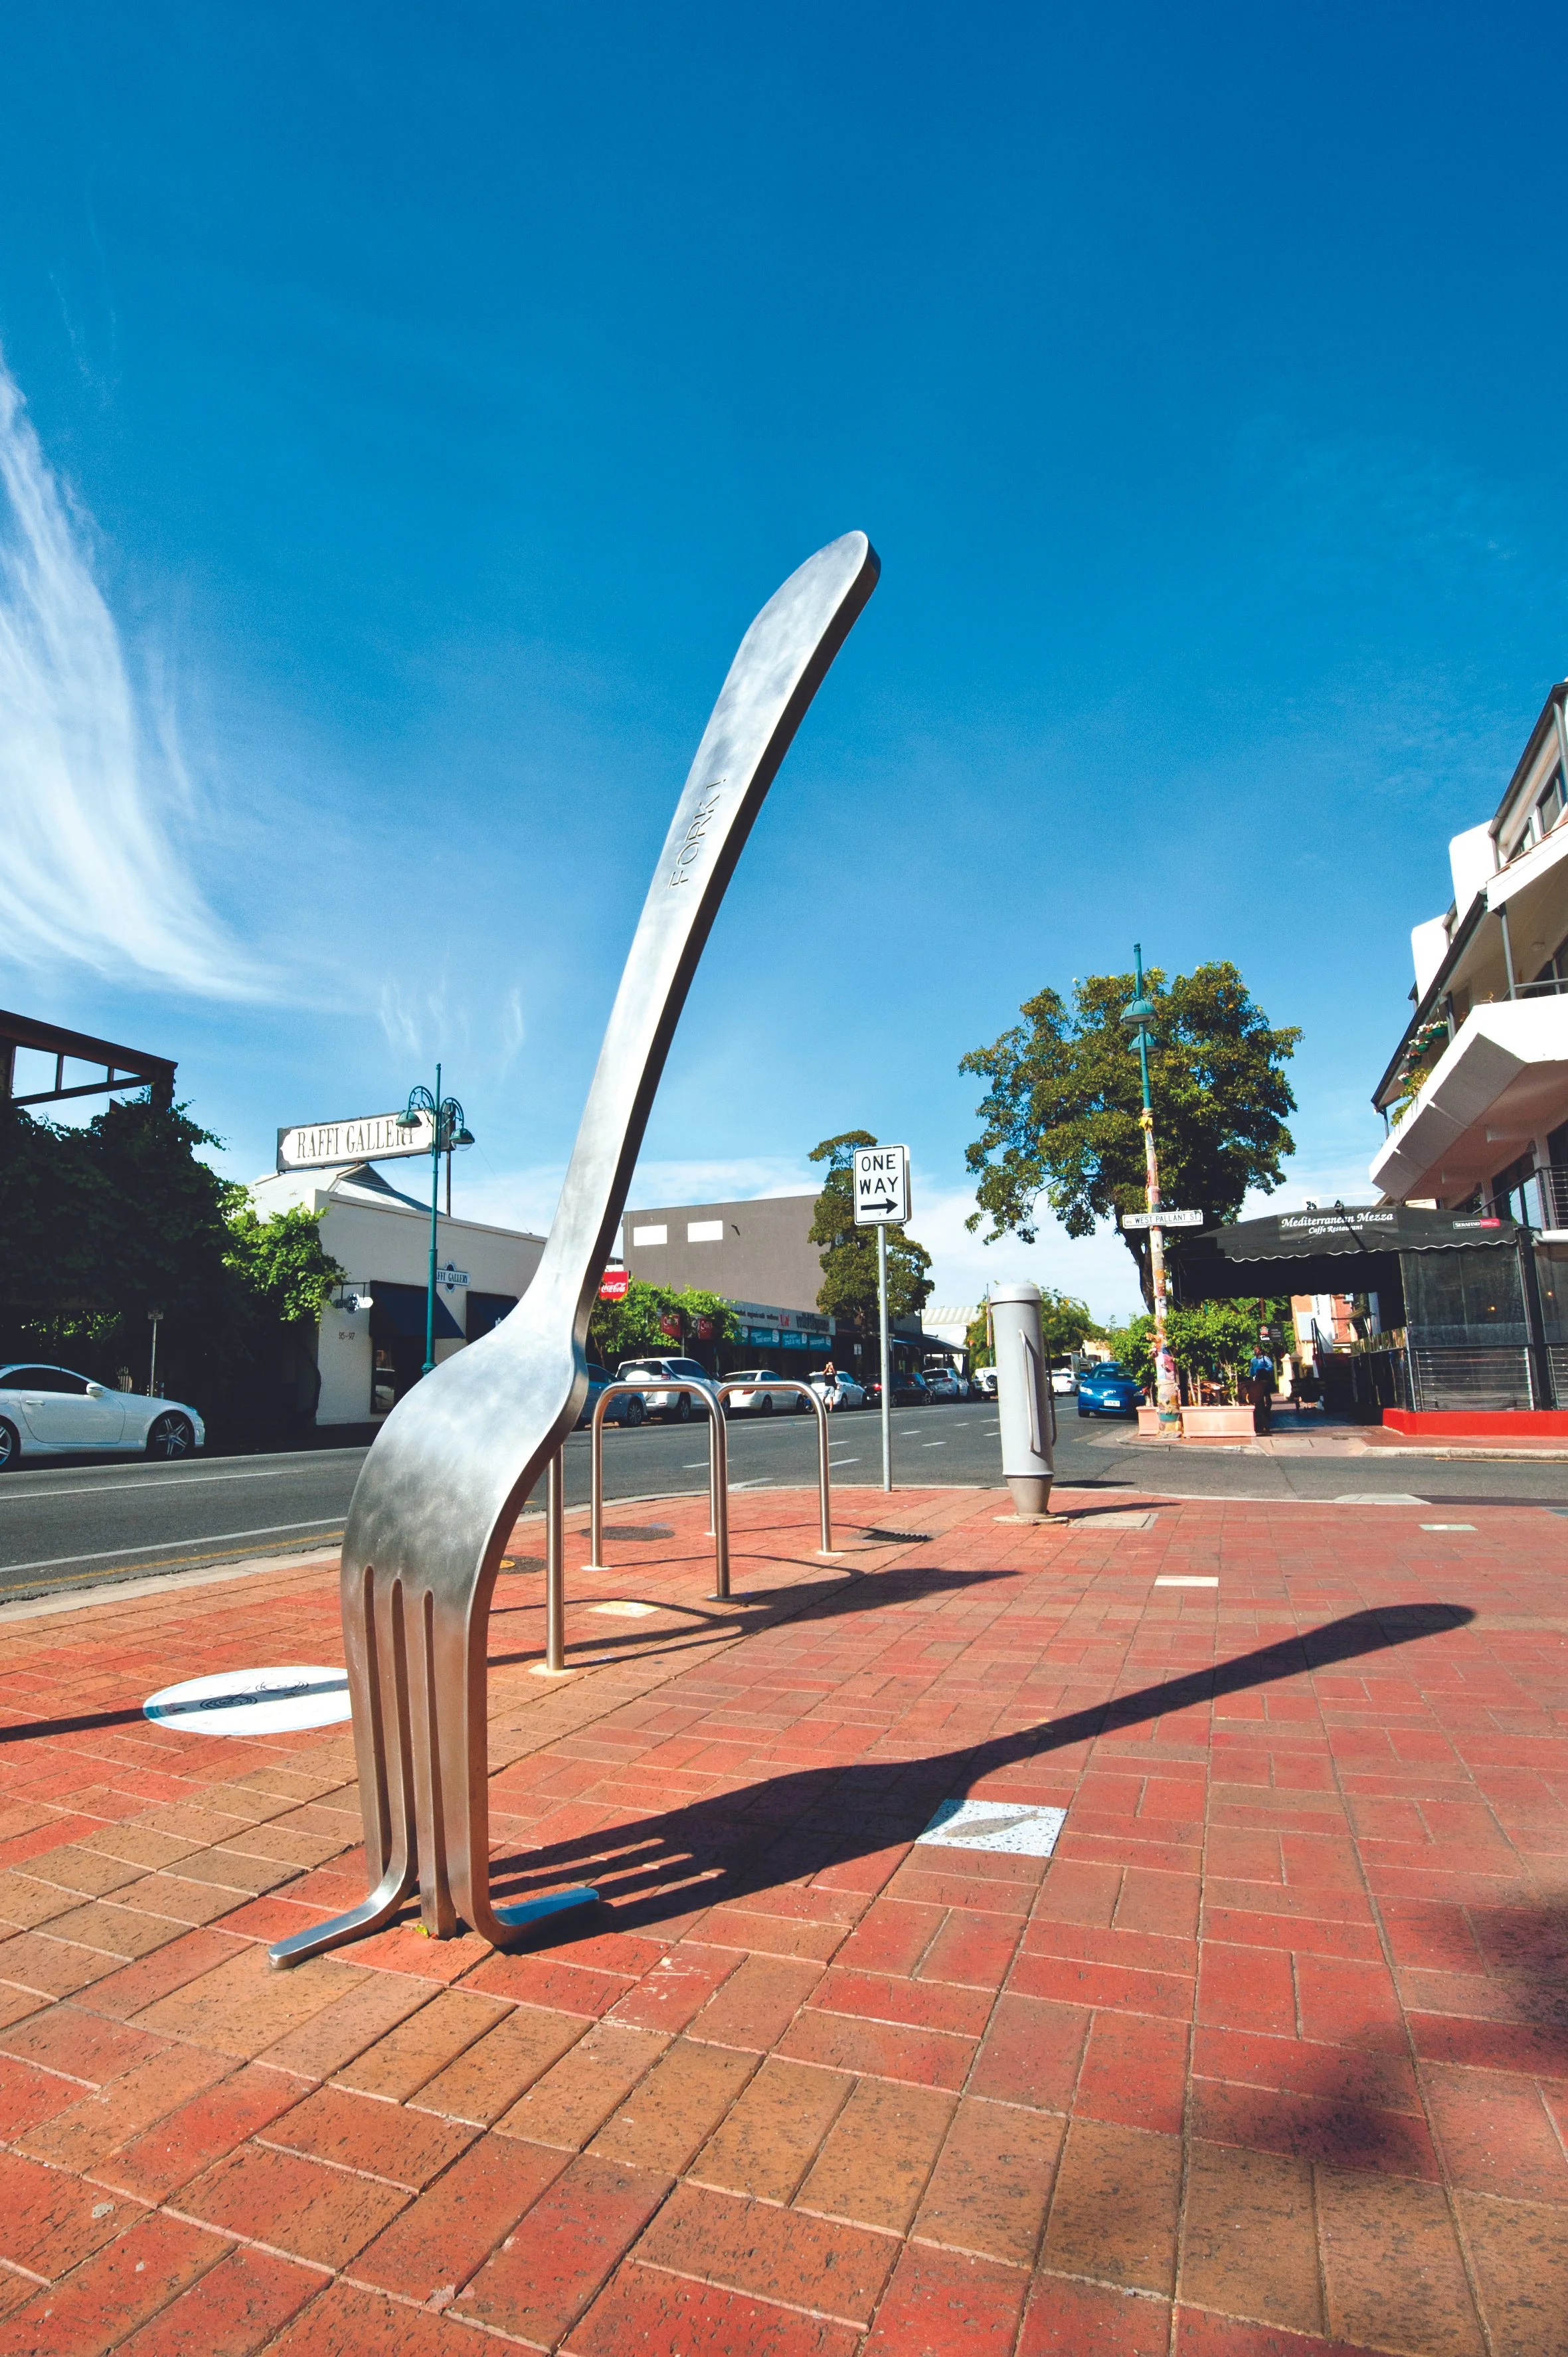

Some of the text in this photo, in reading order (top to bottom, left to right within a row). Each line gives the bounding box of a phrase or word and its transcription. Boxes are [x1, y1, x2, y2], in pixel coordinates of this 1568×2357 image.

[297, 1127, 339, 1159] RAFFI
[861, 1154, 896, 1172] ONE
[859, 1176, 899, 1195] WAY
[1156, 1214, 1186, 1223] PALLANT
[1189, 1211, 1198, 1220] ST
[1357, 1211, 1394, 1223] Mezza
[1308, 1226, 1326, 1235] Caffe
[448, 1272, 468, 1284] GALLERY
